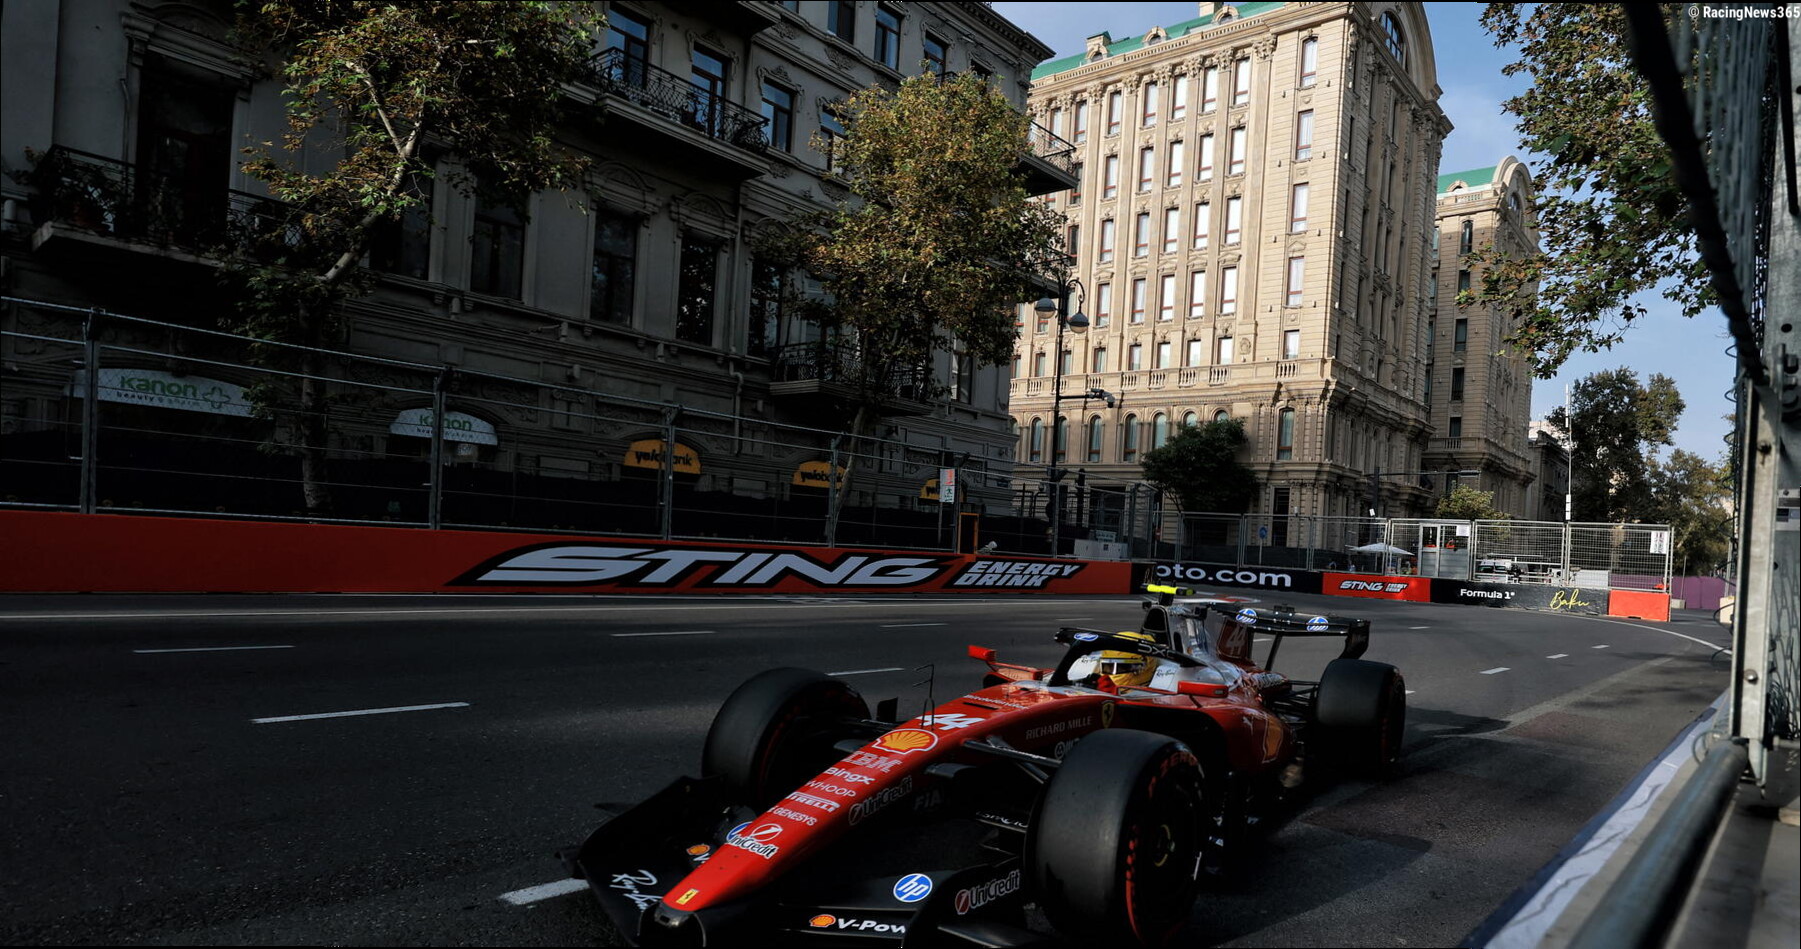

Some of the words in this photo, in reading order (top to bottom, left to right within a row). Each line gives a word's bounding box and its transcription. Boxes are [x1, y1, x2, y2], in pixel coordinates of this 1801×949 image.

[420, 415, 472, 431] knon
[476, 546, 940, 585] STING
[968, 561, 1080, 576] ENERGY
[953, 573, 1049, 586] DRINK
[1340, 580, 1384, 591] STING
[1460, 588, 1503, 599] Formula
[1550, 588, 1590, 610] Baku
[914, 713, 986, 731] 44
[1025, 721, 1067, 740] RICHARD
[1067, 715, 1095, 731] MILLE
[840, 751, 903, 773] IBM
[804, 780, 857, 797] WHOOP
[785, 791, 841, 813] PIRELLI
[775, 807, 818, 826] GENESYS
[896, 874, 930, 901] hp
[968, 869, 1022, 909] UniCredit
